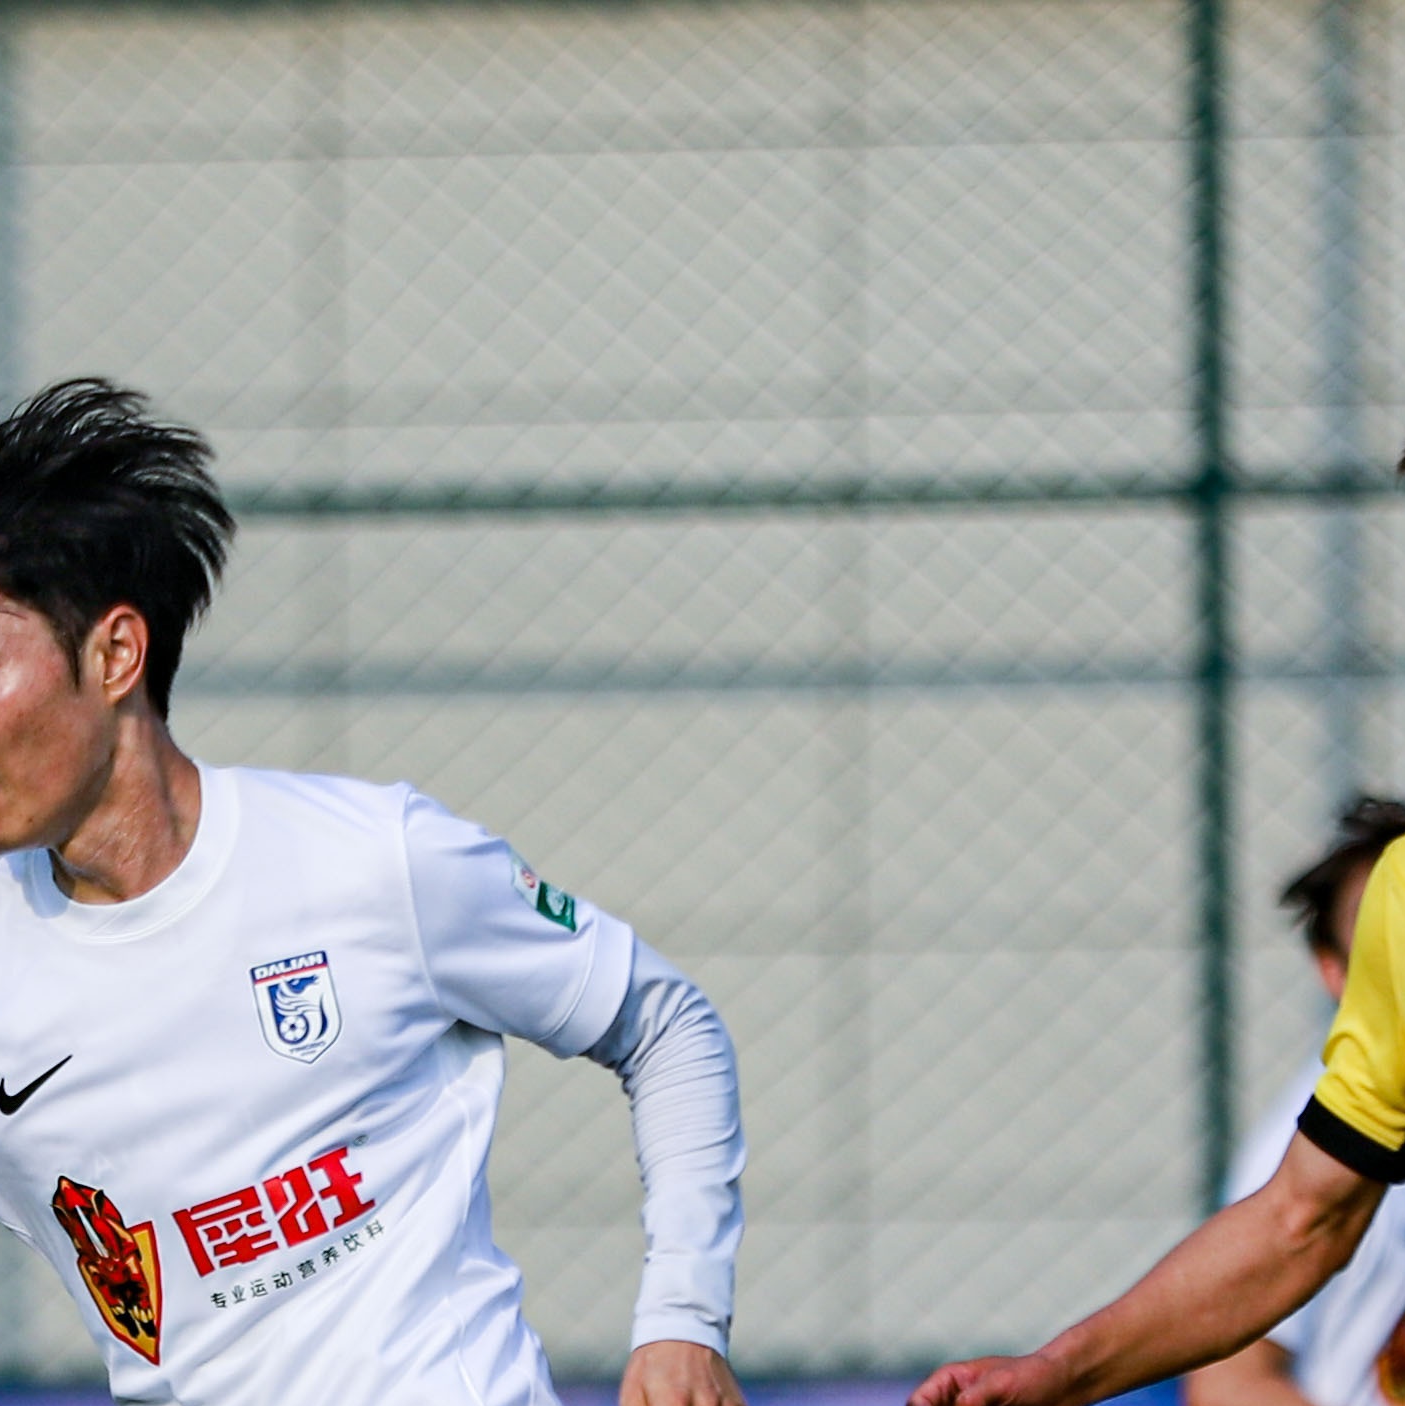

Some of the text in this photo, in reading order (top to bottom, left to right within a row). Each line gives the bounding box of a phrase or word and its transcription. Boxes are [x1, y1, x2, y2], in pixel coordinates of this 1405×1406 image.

[210, 1219, 385, 1309] 专业运动营养饮料
